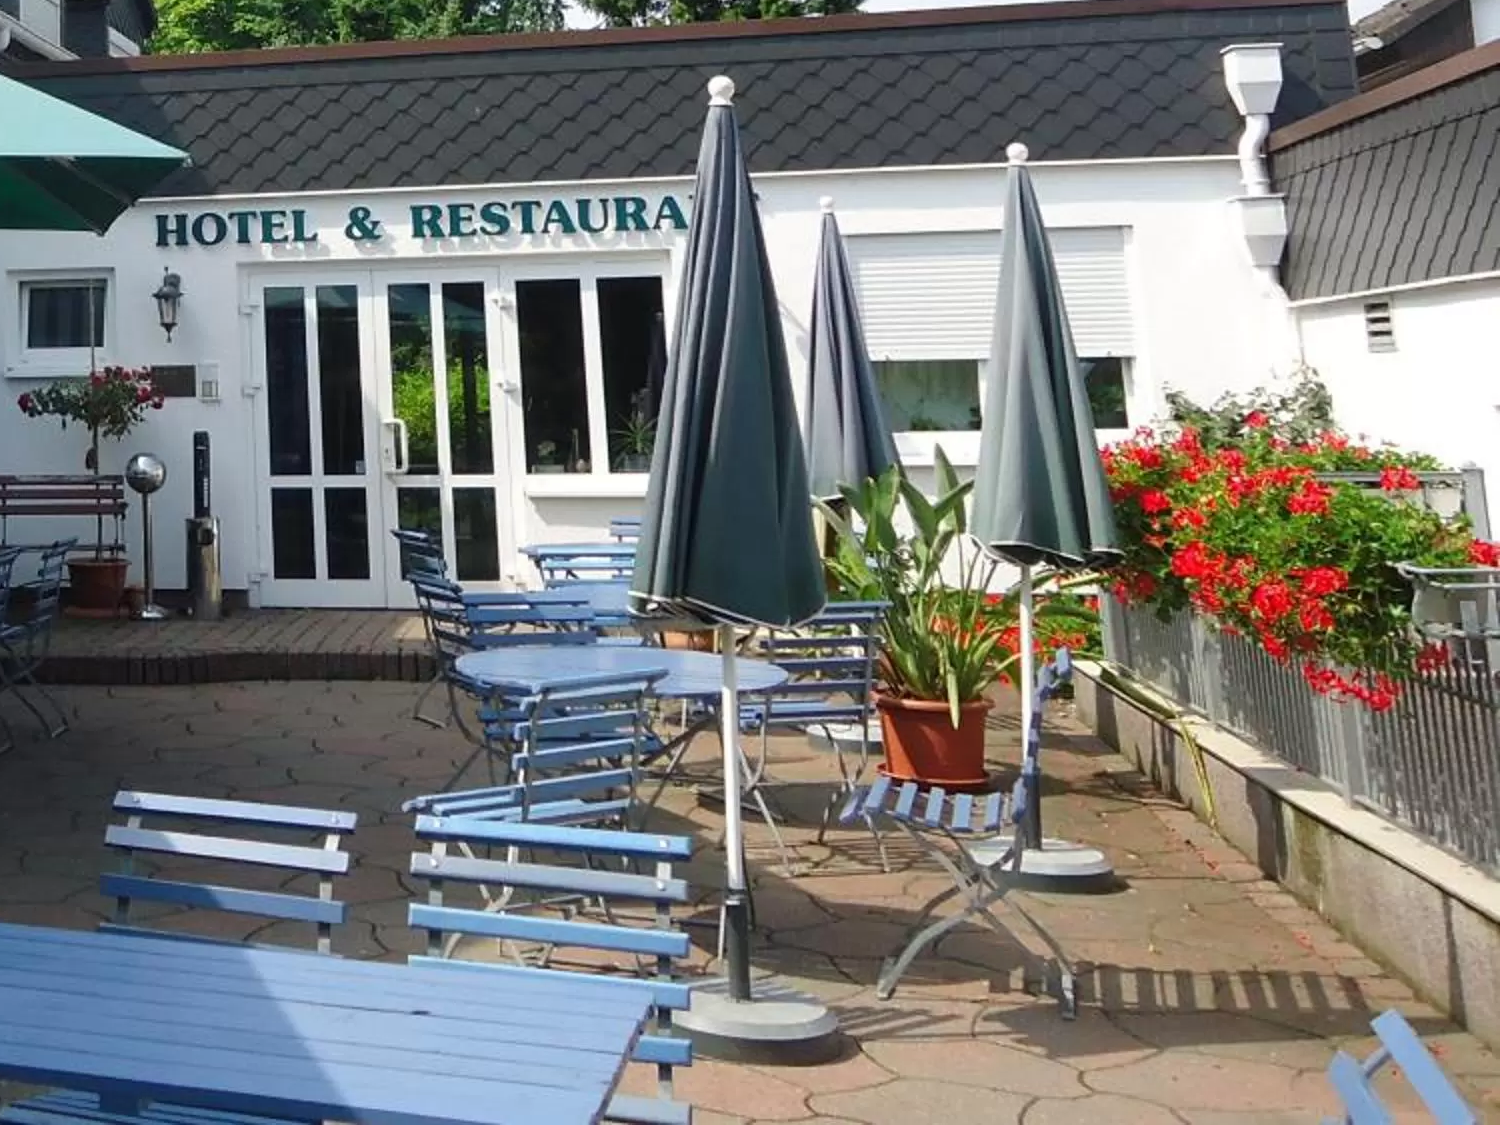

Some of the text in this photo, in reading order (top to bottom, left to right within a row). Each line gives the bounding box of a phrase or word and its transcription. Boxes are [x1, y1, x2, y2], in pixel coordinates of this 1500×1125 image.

[155, 194, 694, 247] HOTEL & RESTAURA
